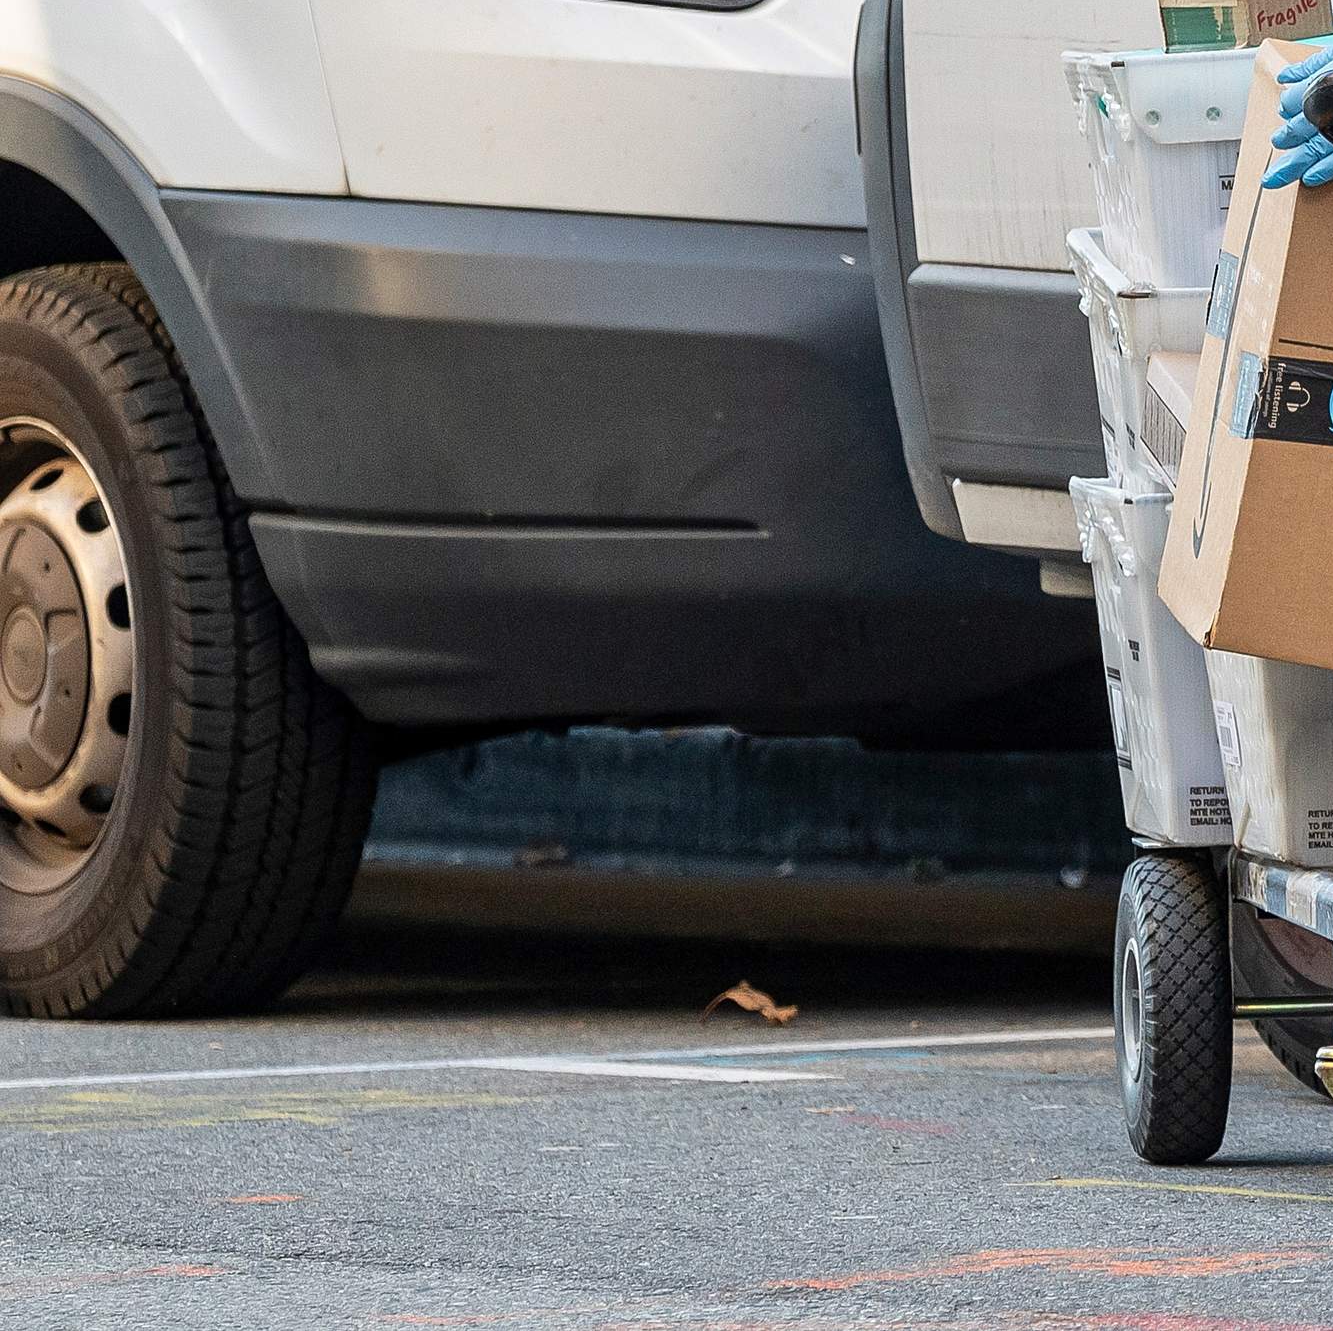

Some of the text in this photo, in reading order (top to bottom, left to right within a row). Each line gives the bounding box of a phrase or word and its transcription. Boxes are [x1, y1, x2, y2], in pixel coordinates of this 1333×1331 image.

[1267, 362, 1287, 429] free listening
[1190, 786, 1224, 795] RETURN
[1190, 799, 1229, 807] TO REPO
[1190, 808, 1208, 816] MTE
[1308, 822, 1320, 830] TO
[1308, 831, 1325, 839] MTE
